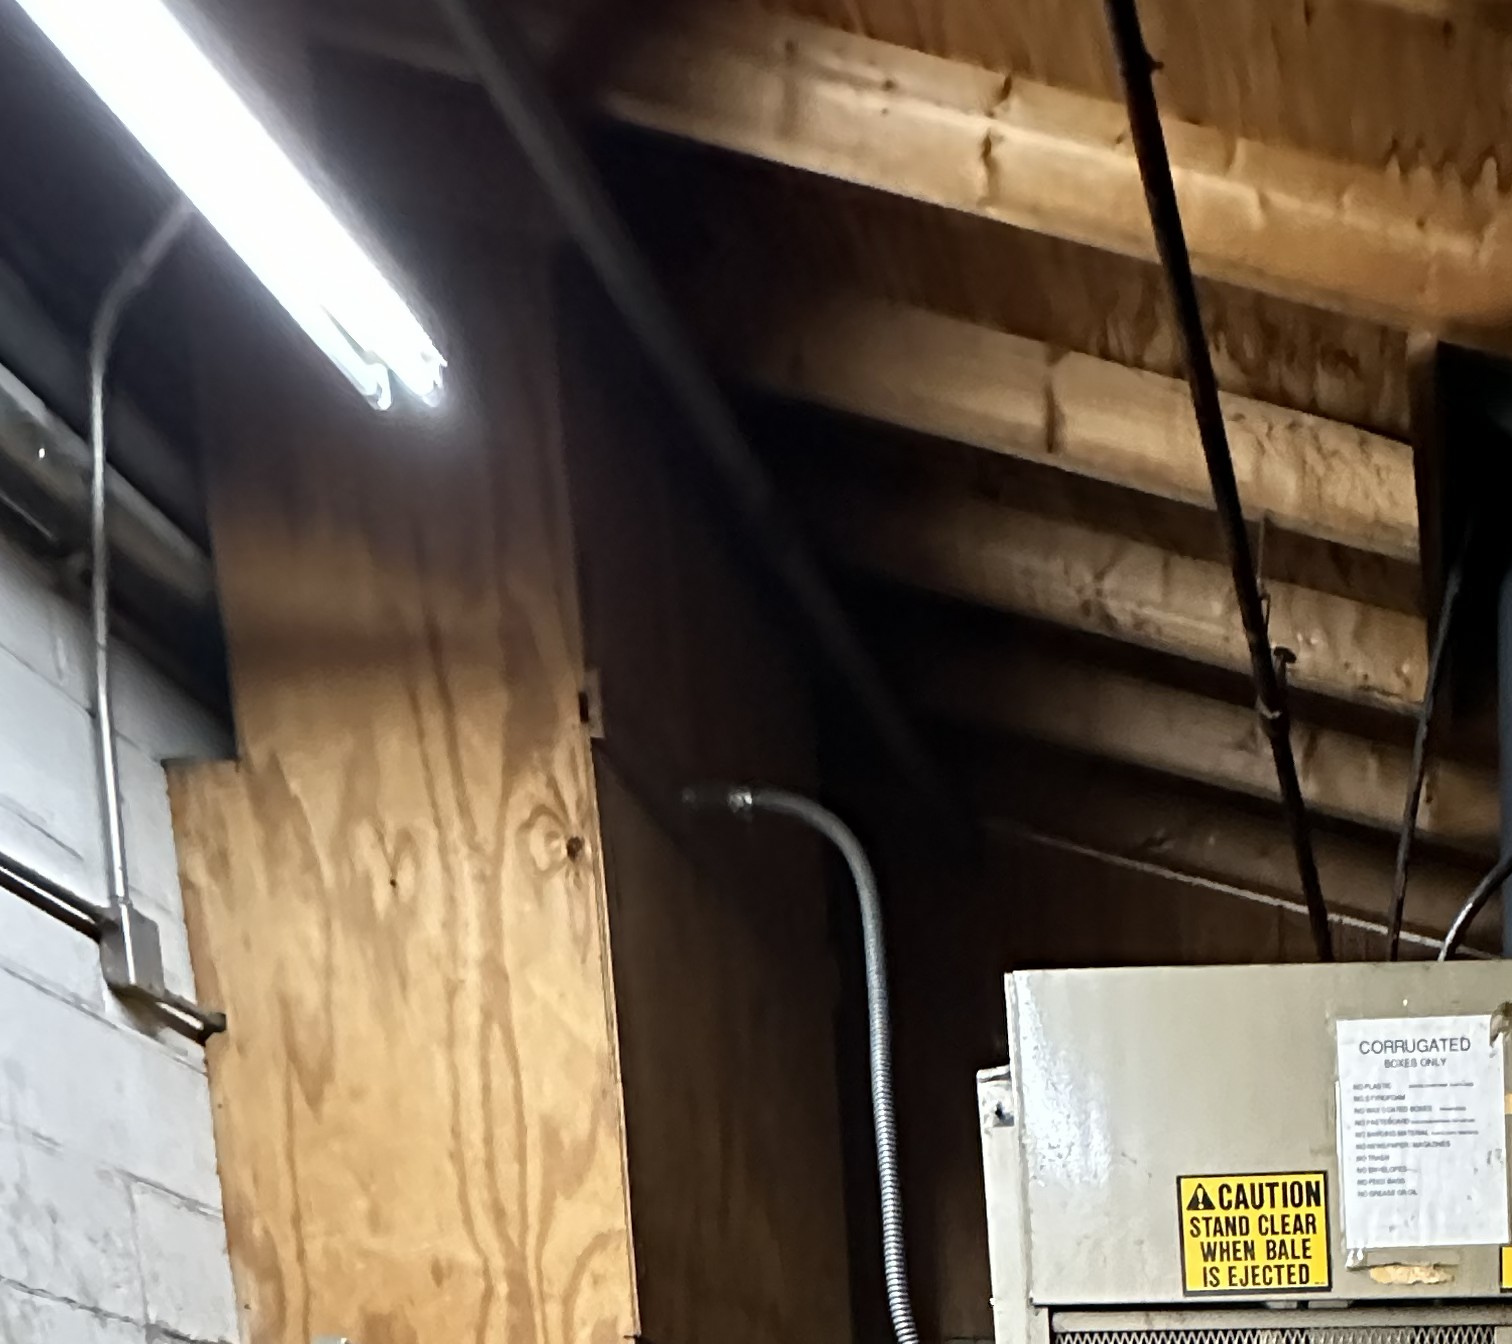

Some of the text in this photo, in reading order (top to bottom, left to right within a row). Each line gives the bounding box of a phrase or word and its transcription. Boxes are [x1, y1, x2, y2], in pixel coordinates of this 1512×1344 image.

[1359, 1036, 1471, 1055] CORRUGATED
[1384, 1057, 1447, 1068] BOXES ONLY
[1218, 1180, 1321, 1210] CAUTION
[1189, 1213, 1317, 1238] STAND CLEAR
[1200, 1238, 1312, 1262] WHEN BALE
[1203, 1263, 1309, 1288] IS EJECTED
